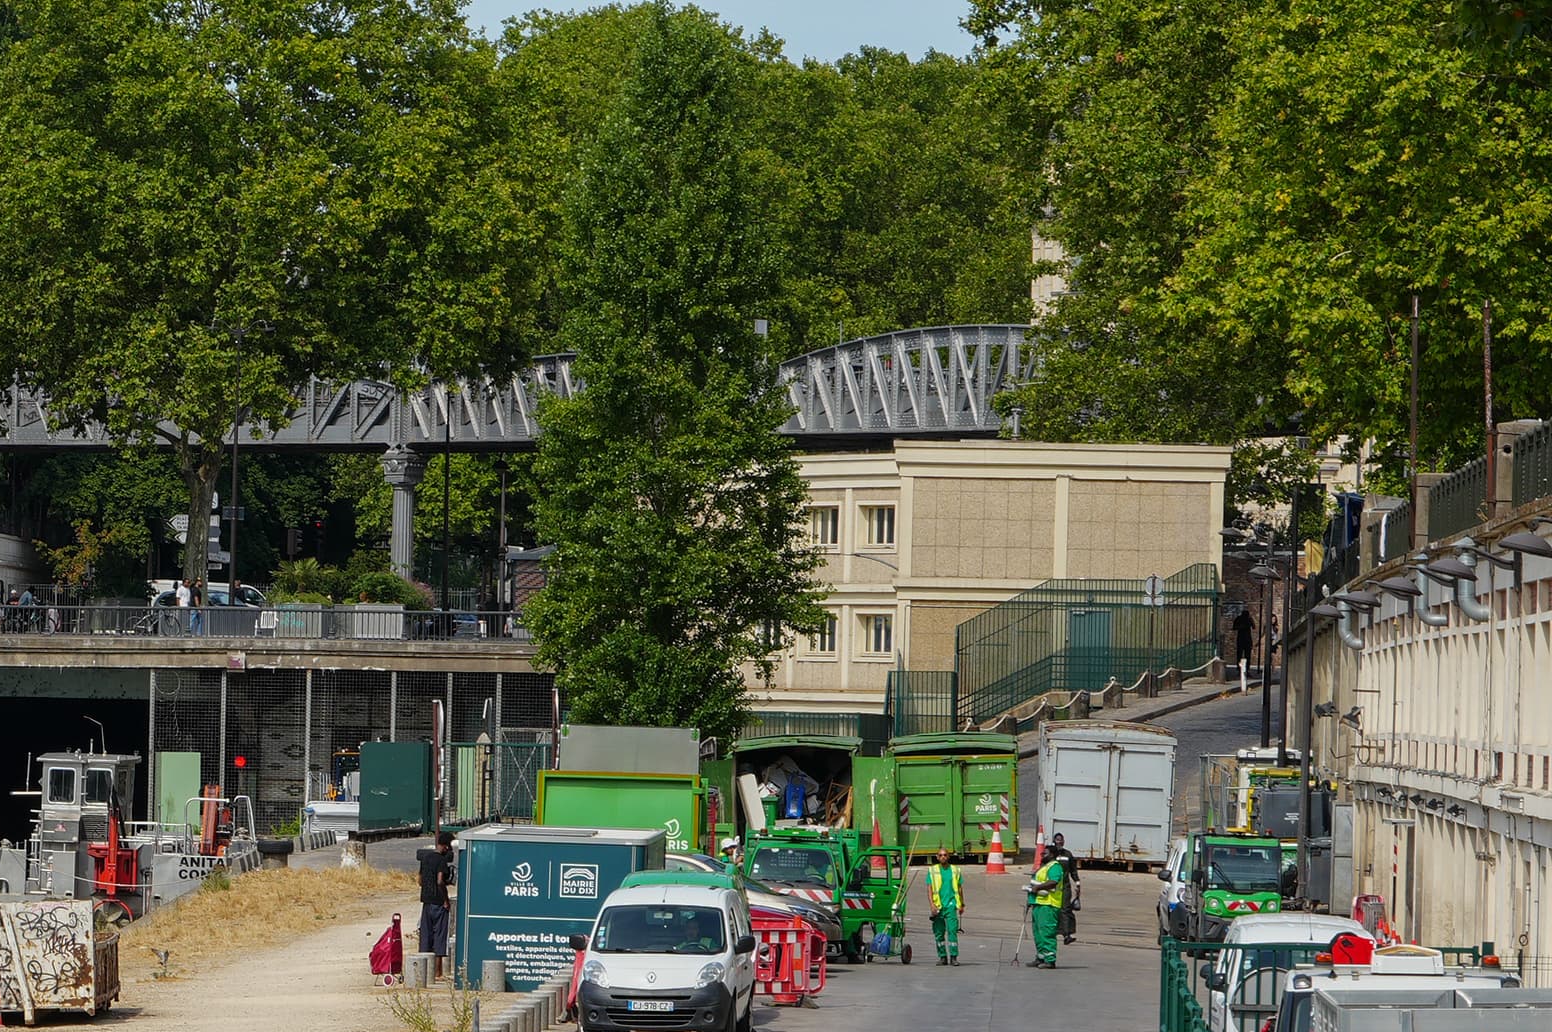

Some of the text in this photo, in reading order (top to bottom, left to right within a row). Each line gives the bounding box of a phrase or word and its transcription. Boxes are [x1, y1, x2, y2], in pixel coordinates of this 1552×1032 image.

[975, 804, 998, 812] PARIS
[665, 840, 689, 850] RIS
[179, 856, 226, 868] ANITA
[563, 880, 595, 888] MAIRIE
[504, 886, 539, 897] PARIS
[578, 887, 595, 895] DIX
[488, 932, 538, 943] Apportez
[540, 933, 554, 943] ici
